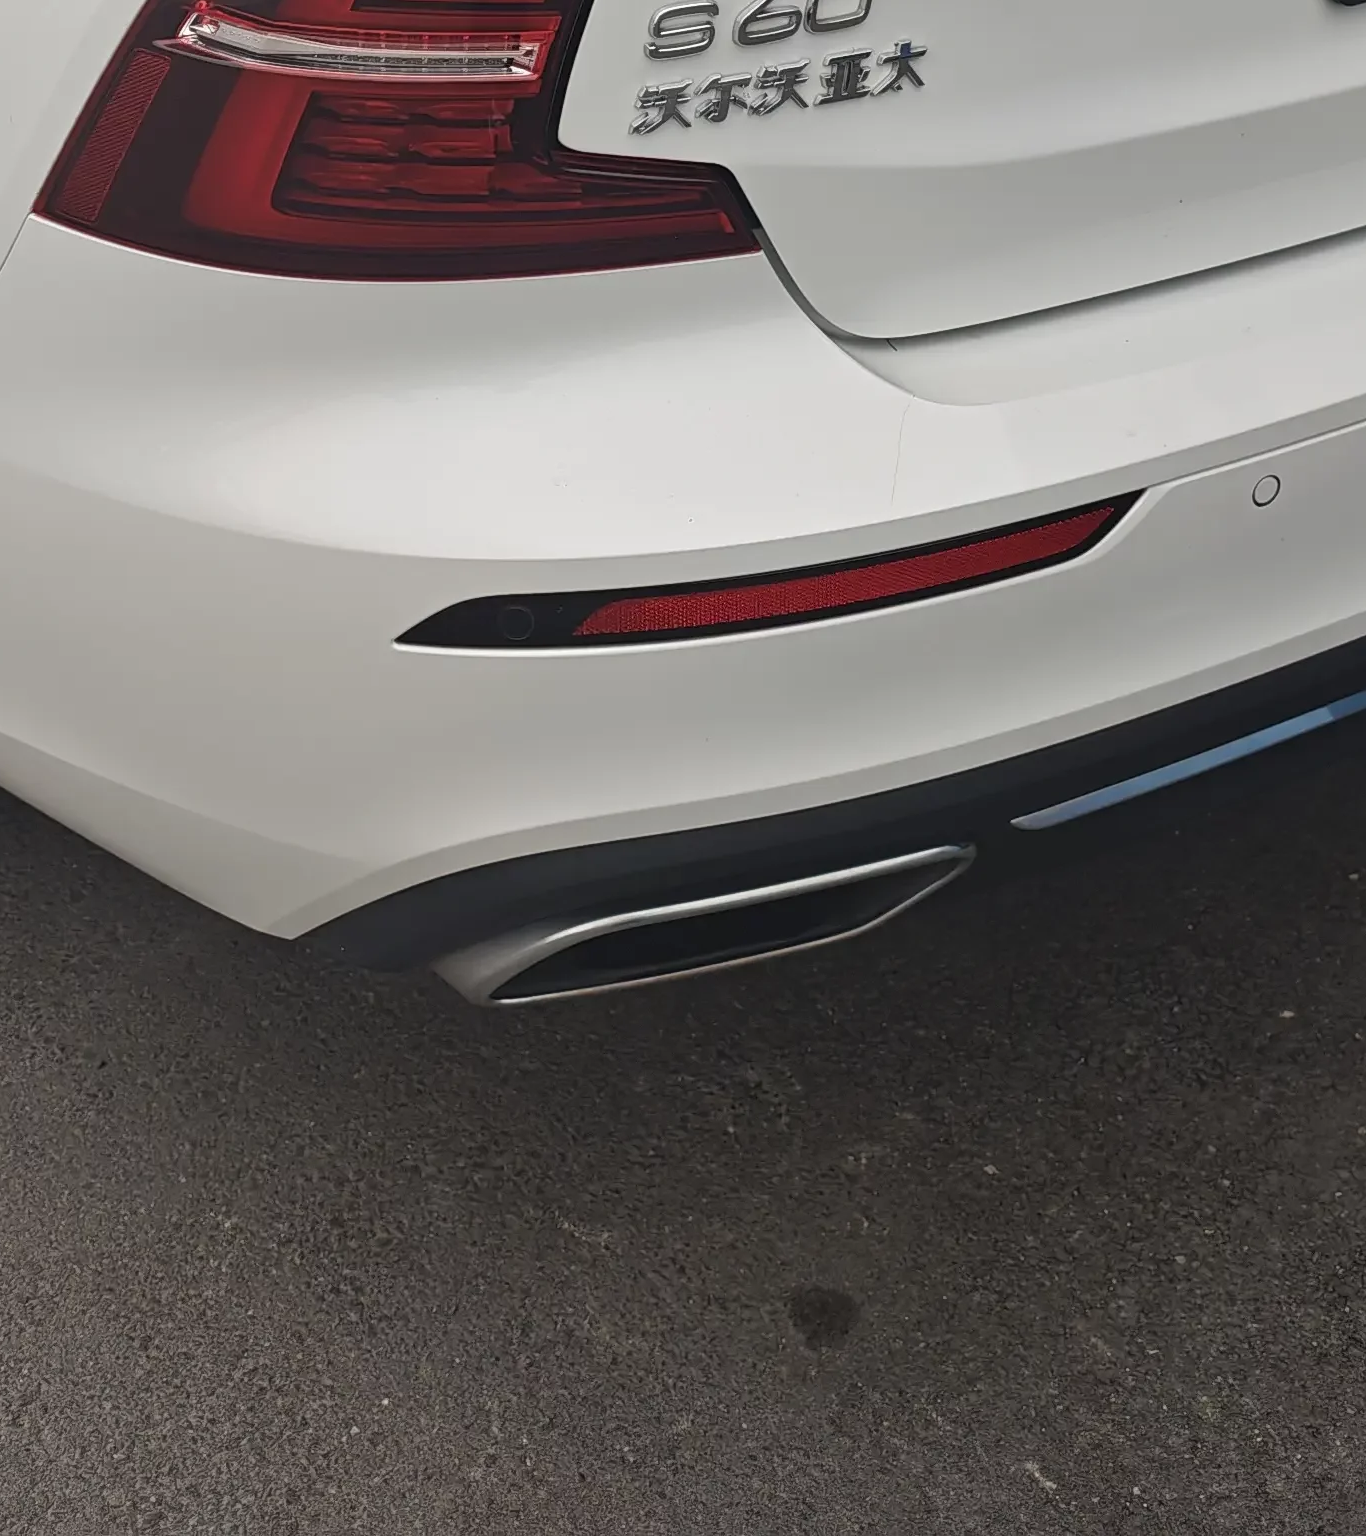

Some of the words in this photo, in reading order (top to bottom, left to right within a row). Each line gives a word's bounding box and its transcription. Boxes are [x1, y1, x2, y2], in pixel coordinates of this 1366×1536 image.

[628, 38, 929, 136] 沃尔沃亚太
